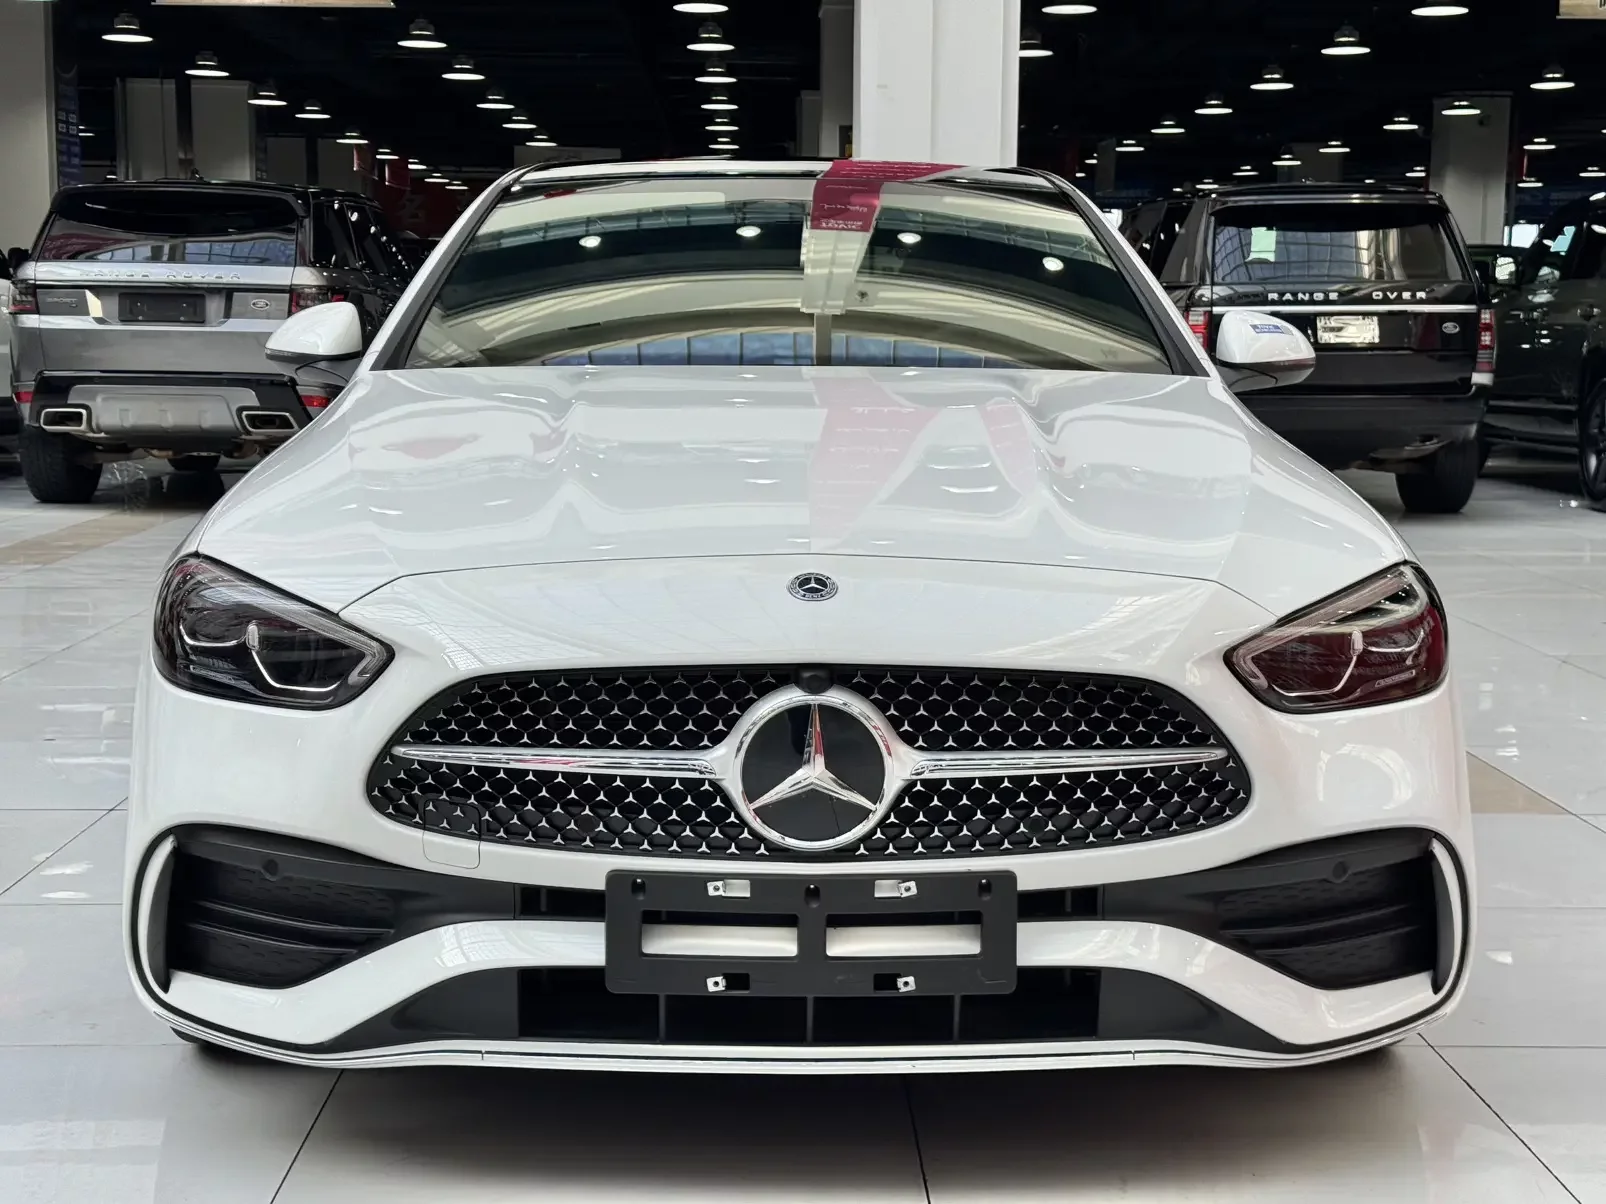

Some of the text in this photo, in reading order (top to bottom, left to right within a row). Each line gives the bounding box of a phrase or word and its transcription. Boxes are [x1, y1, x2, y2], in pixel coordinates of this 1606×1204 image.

[166, 271, 242, 280] ROVER
[1267, 291, 1427, 301] RANGE OVER
